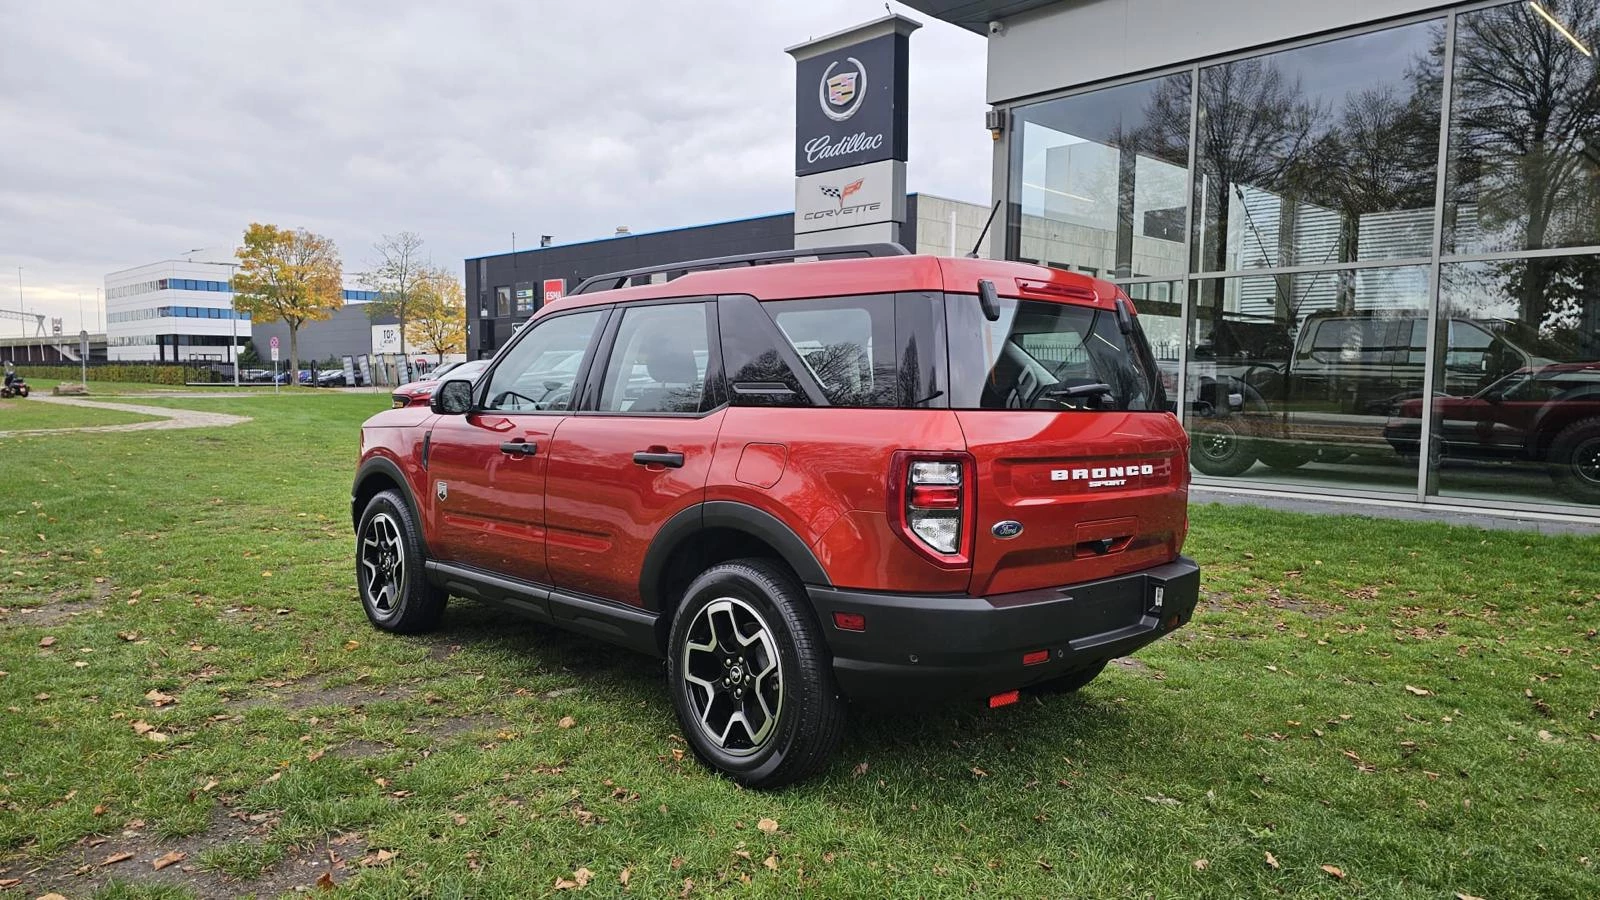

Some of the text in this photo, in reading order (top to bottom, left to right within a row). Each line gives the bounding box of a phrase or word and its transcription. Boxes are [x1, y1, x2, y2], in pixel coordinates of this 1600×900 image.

[804, 132, 883, 163] Cadillac
[804, 202, 881, 221] CORVETTE
[383, 330, 394, 339] TOP
[1051, 464, 1153, 481] BRONCO
[1088, 479, 1127, 488] SPORT
